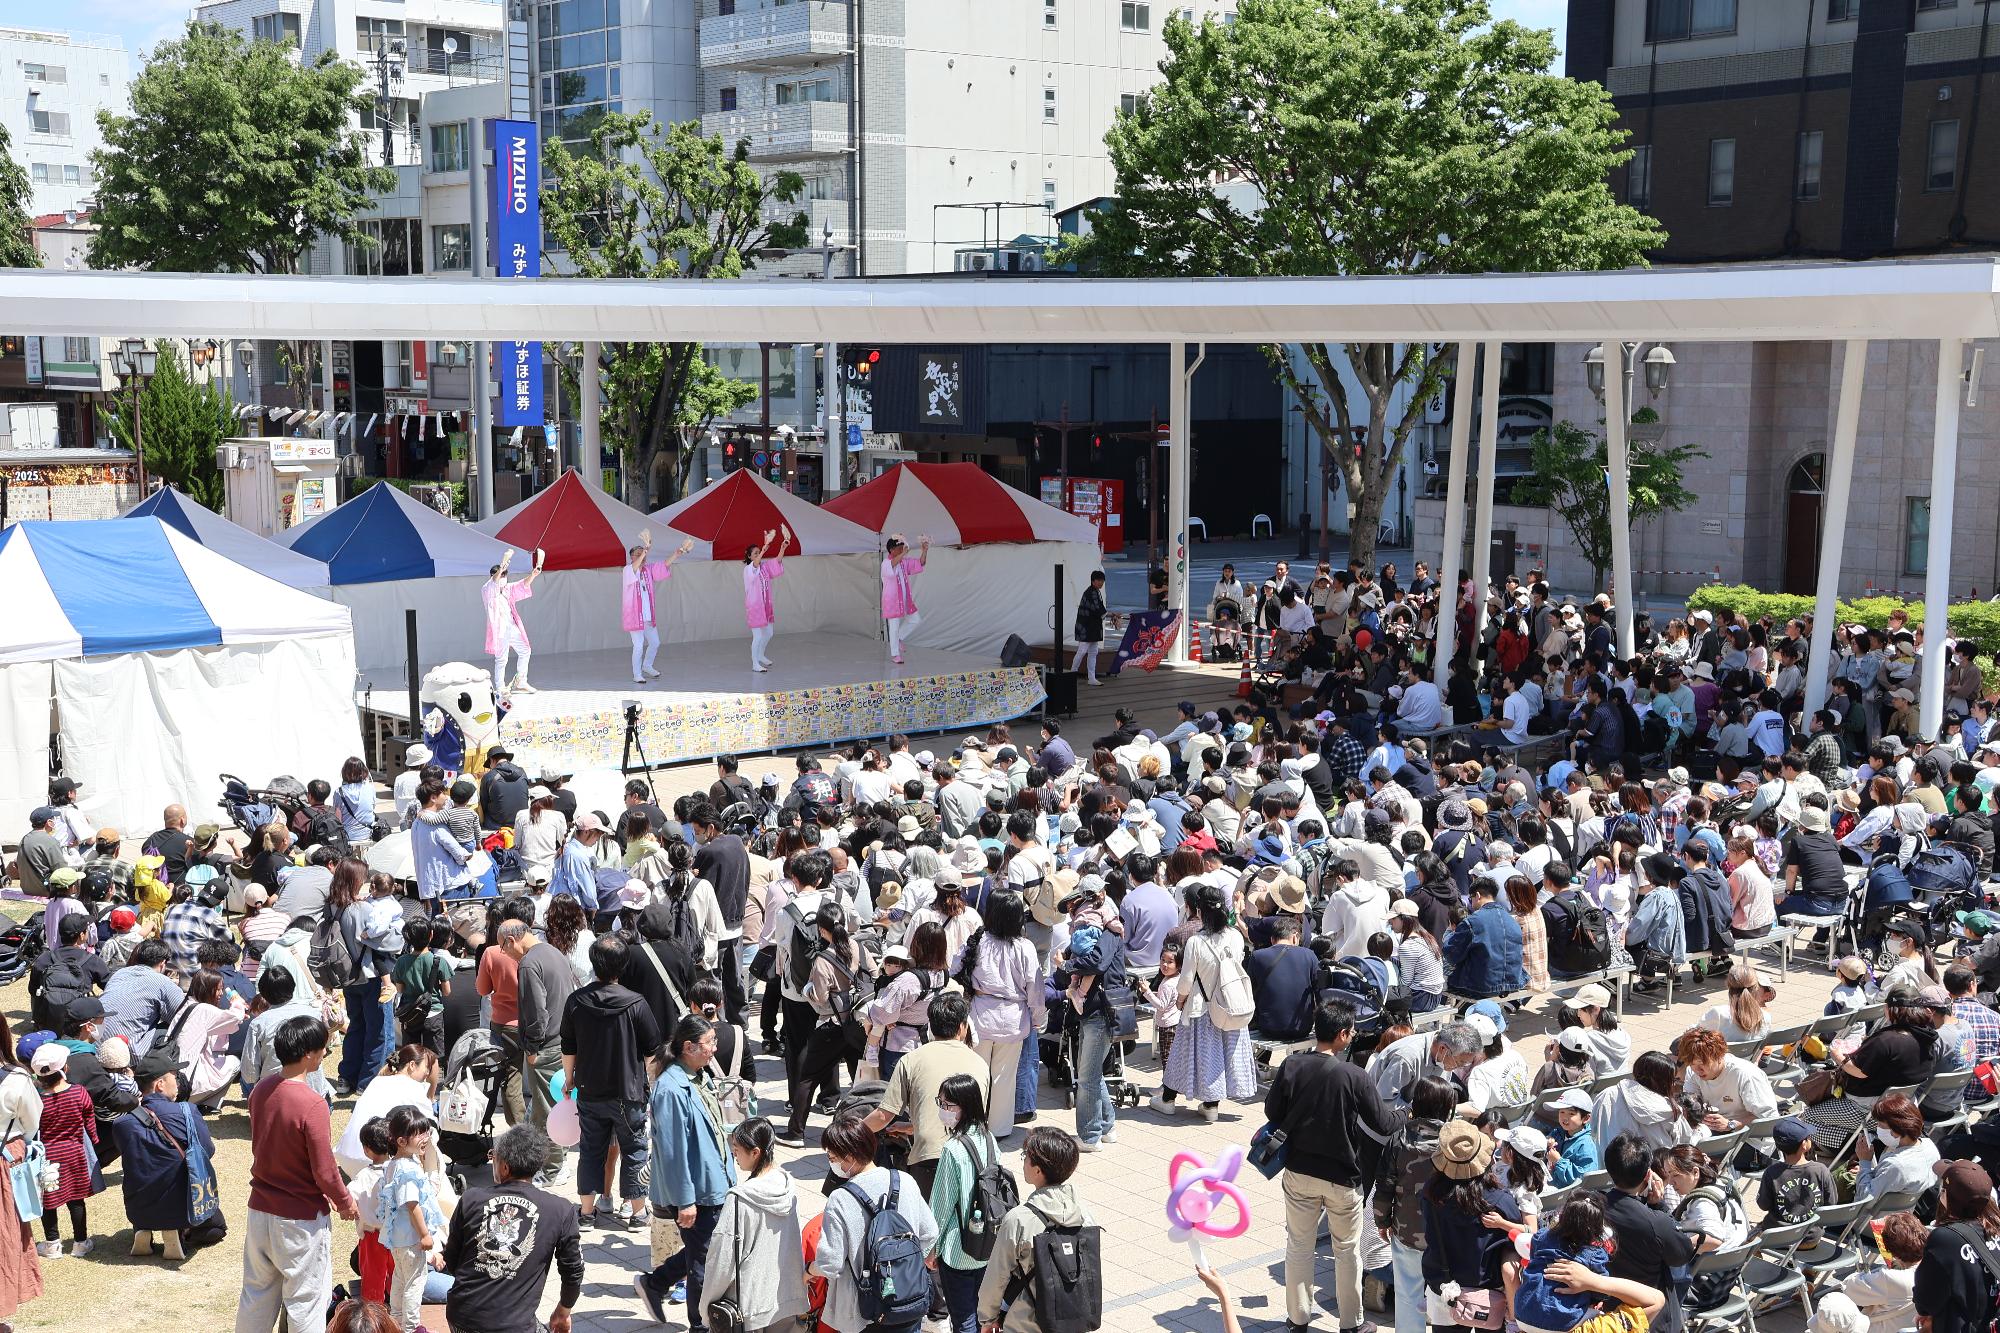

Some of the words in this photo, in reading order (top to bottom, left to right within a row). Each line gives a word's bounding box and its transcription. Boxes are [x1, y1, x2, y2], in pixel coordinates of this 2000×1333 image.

[512, 136, 527, 214] MIZUHO
[513, 243, 527, 278] みず
[308, 447, 331, 456] 宝くじ
[15, 470, 39, 481] 2025
[1777, 1178, 1821, 1203] EVERYDAY
[494, 1196, 533, 1209] VANSON
